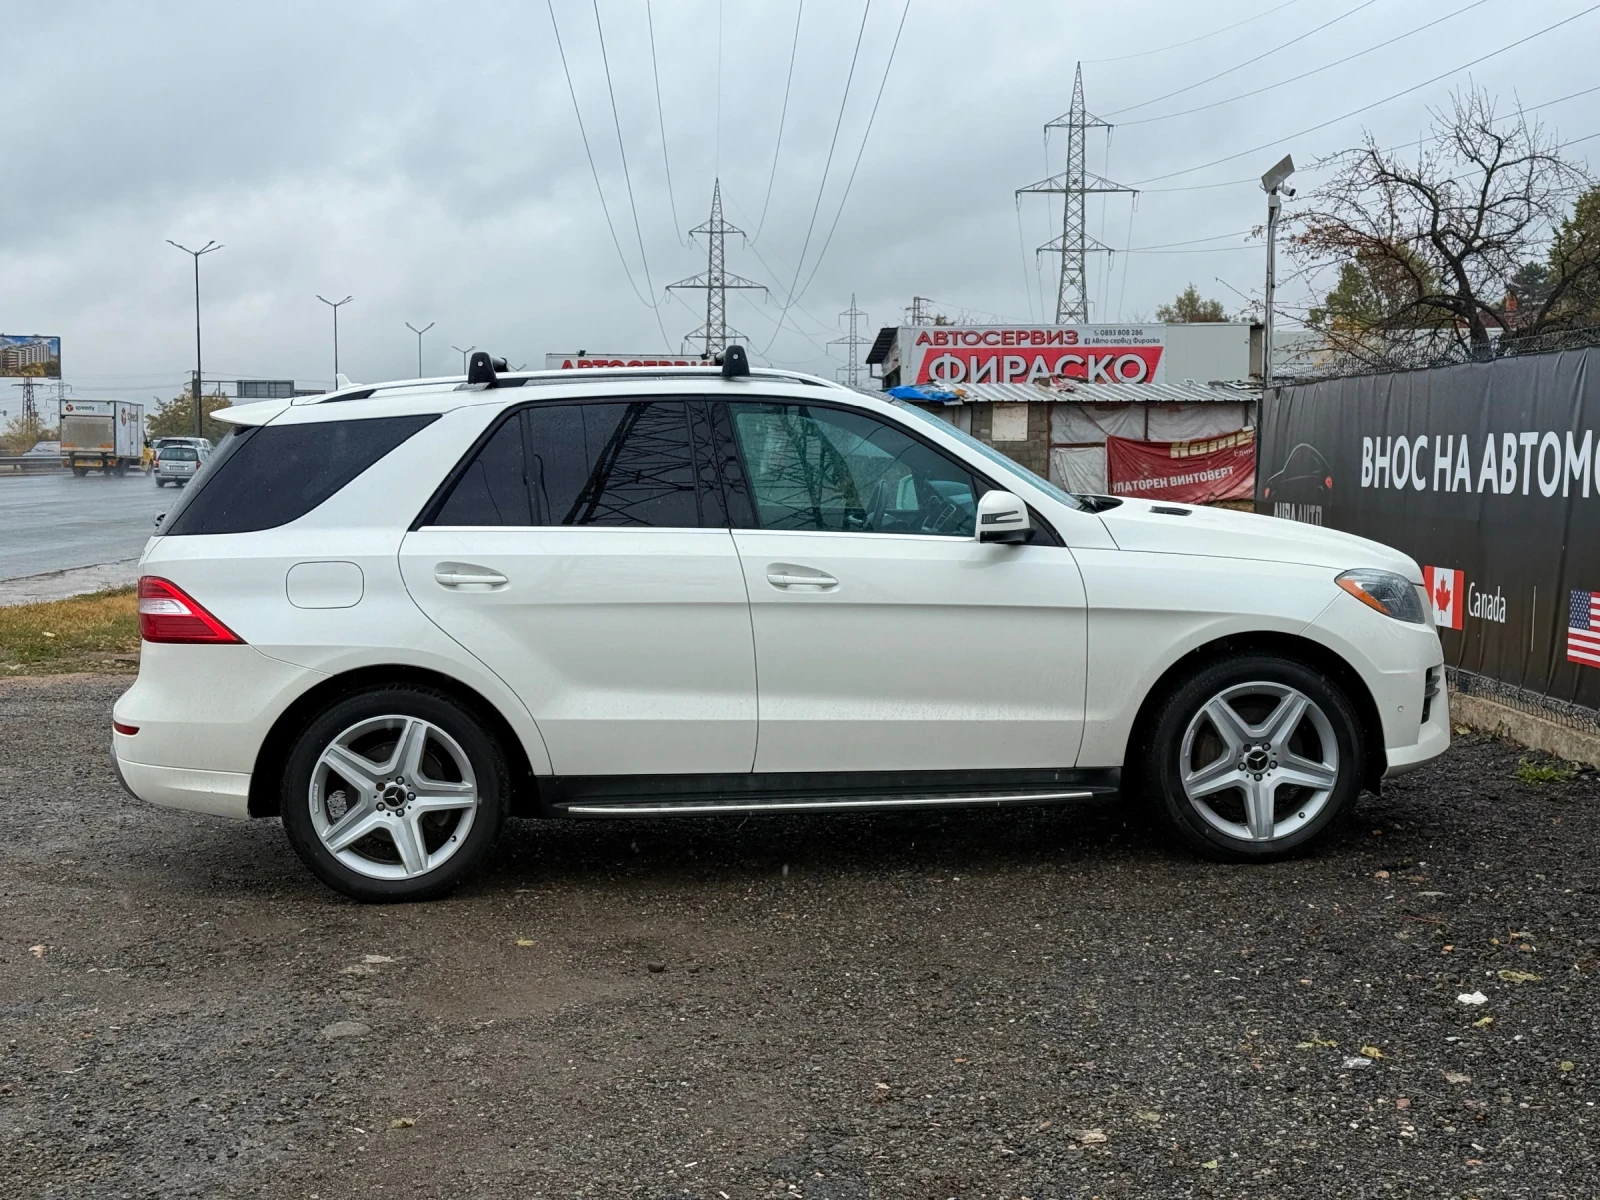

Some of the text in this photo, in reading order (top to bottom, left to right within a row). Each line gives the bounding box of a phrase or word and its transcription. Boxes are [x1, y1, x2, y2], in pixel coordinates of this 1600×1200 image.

[915, 330, 1079, 346] АВТОСЕРВИЗ
[928, 352, 1149, 384] ФИРАСКО
[1170, 467, 1234, 487] ВИНТОВЕРТ
[1361, 430, 1600, 498] ВНОС НА АВТОМ
[1468, 582, 1506, 623] Canada
